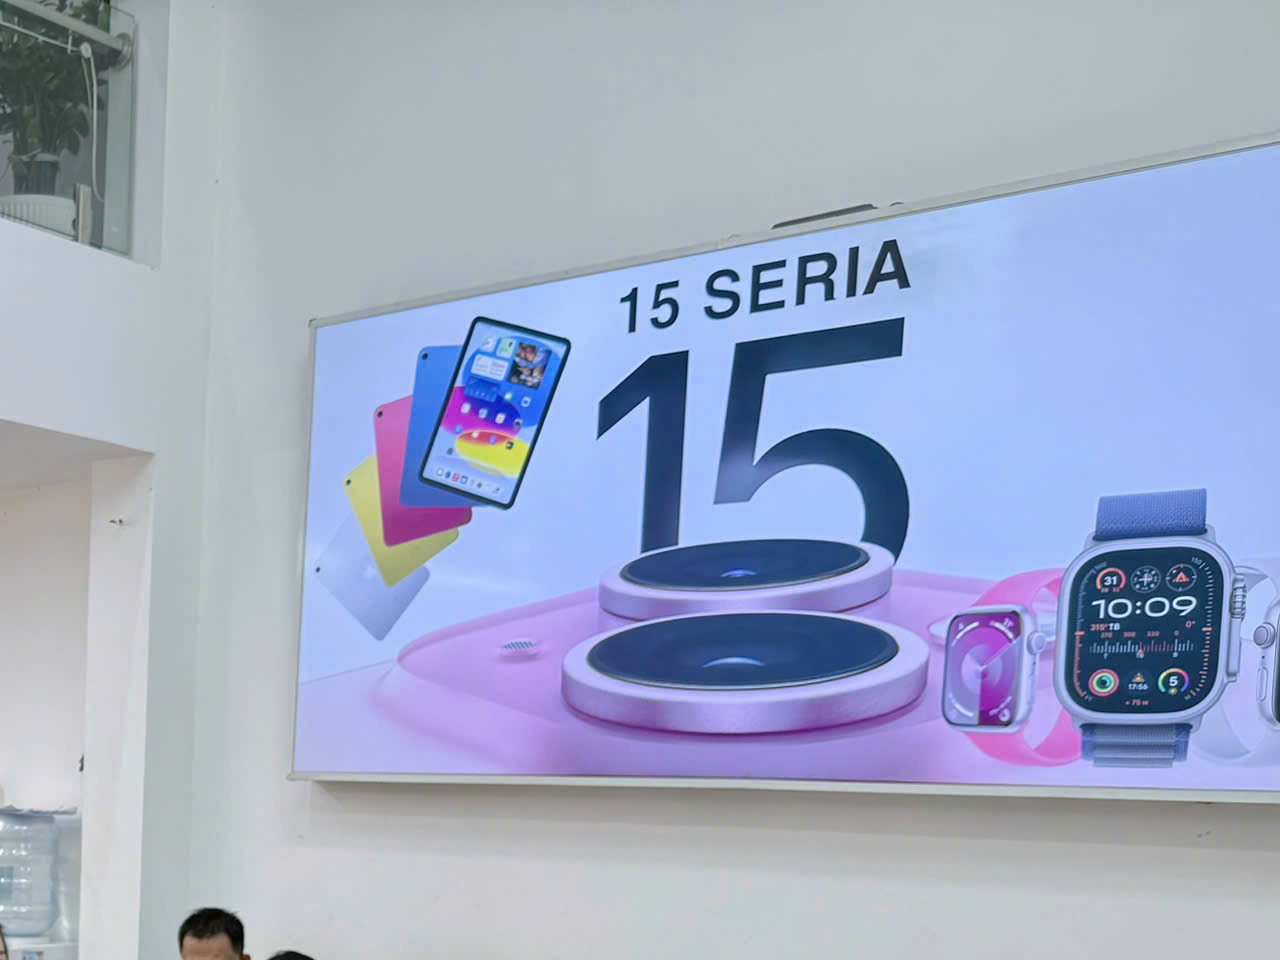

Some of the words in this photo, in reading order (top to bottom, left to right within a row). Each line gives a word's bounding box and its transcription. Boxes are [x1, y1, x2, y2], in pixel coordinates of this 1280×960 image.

[620, 280, 681, 334] 15
[704, 238, 913, 320] SERIA
[596, 316, 911, 566] 15
[1104, 576, 1117, 585] 31
[1091, 596, 1197, 619] 10:09
[1169, 676, 1178, 686] 5
